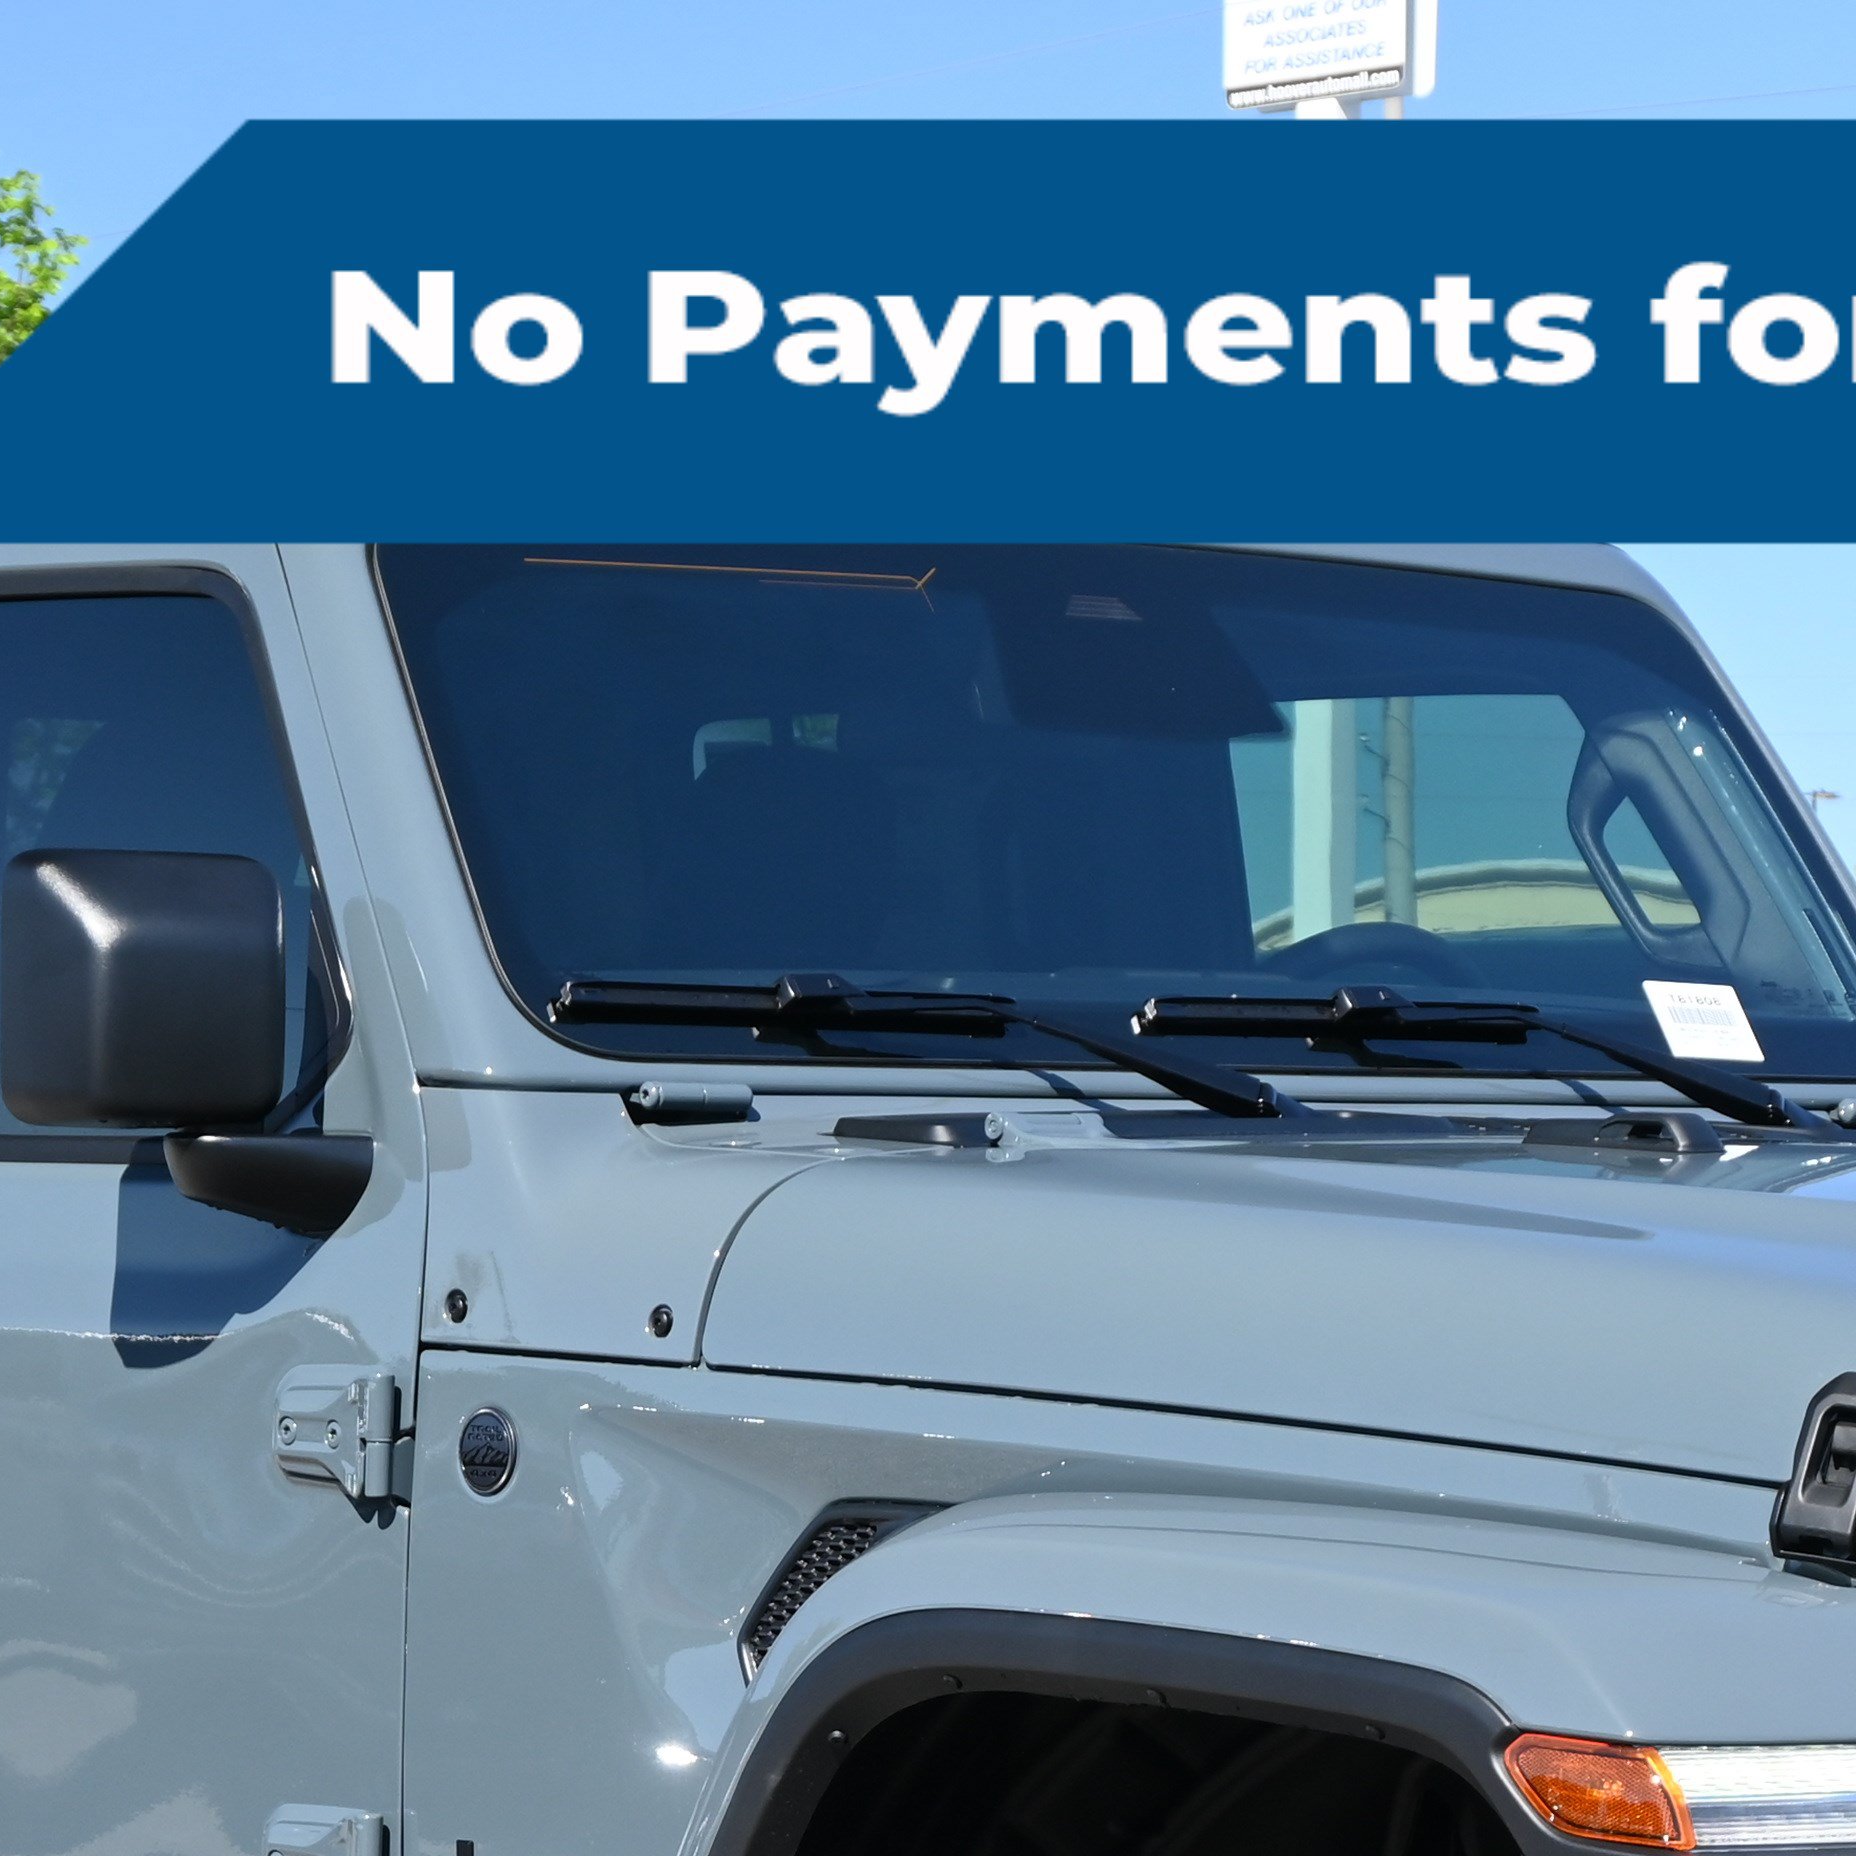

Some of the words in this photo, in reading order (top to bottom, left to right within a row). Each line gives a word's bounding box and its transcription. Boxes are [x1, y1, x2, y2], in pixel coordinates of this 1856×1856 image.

[1244, 8, 1275, 26] ASK
[1283, 2, 1317, 21] ONE
[1263, 19, 1368, 48] ASSOCIATES
[1245, 57, 1277, 74] FOR
[1283, 41, 1387, 69] ASSISTANCE
